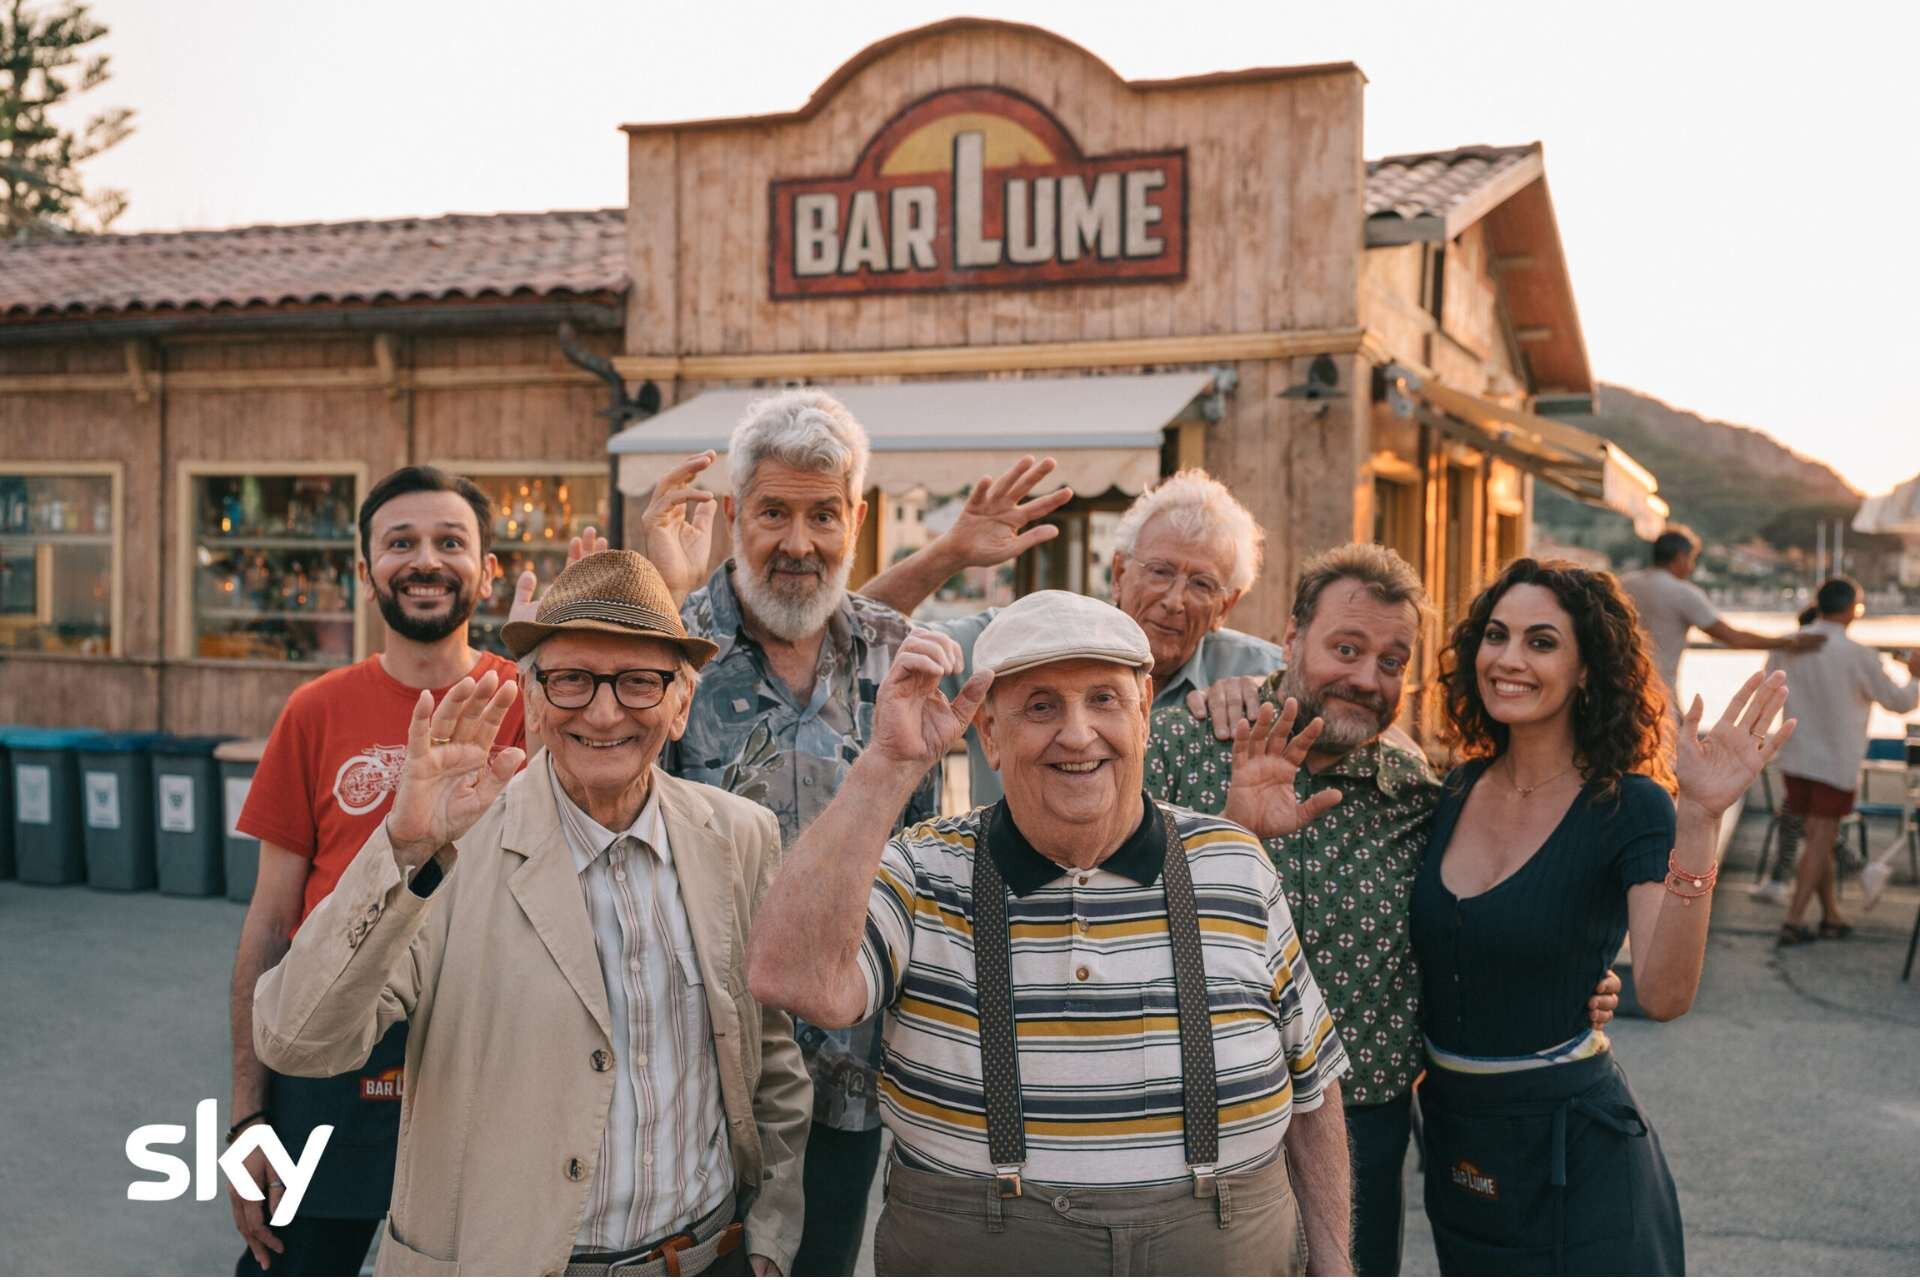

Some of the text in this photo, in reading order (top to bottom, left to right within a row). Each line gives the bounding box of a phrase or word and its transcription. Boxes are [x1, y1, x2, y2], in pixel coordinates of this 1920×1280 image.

[794, 129, 1166, 277] BAR LUME
[366, 1080, 394, 1097] BAR
